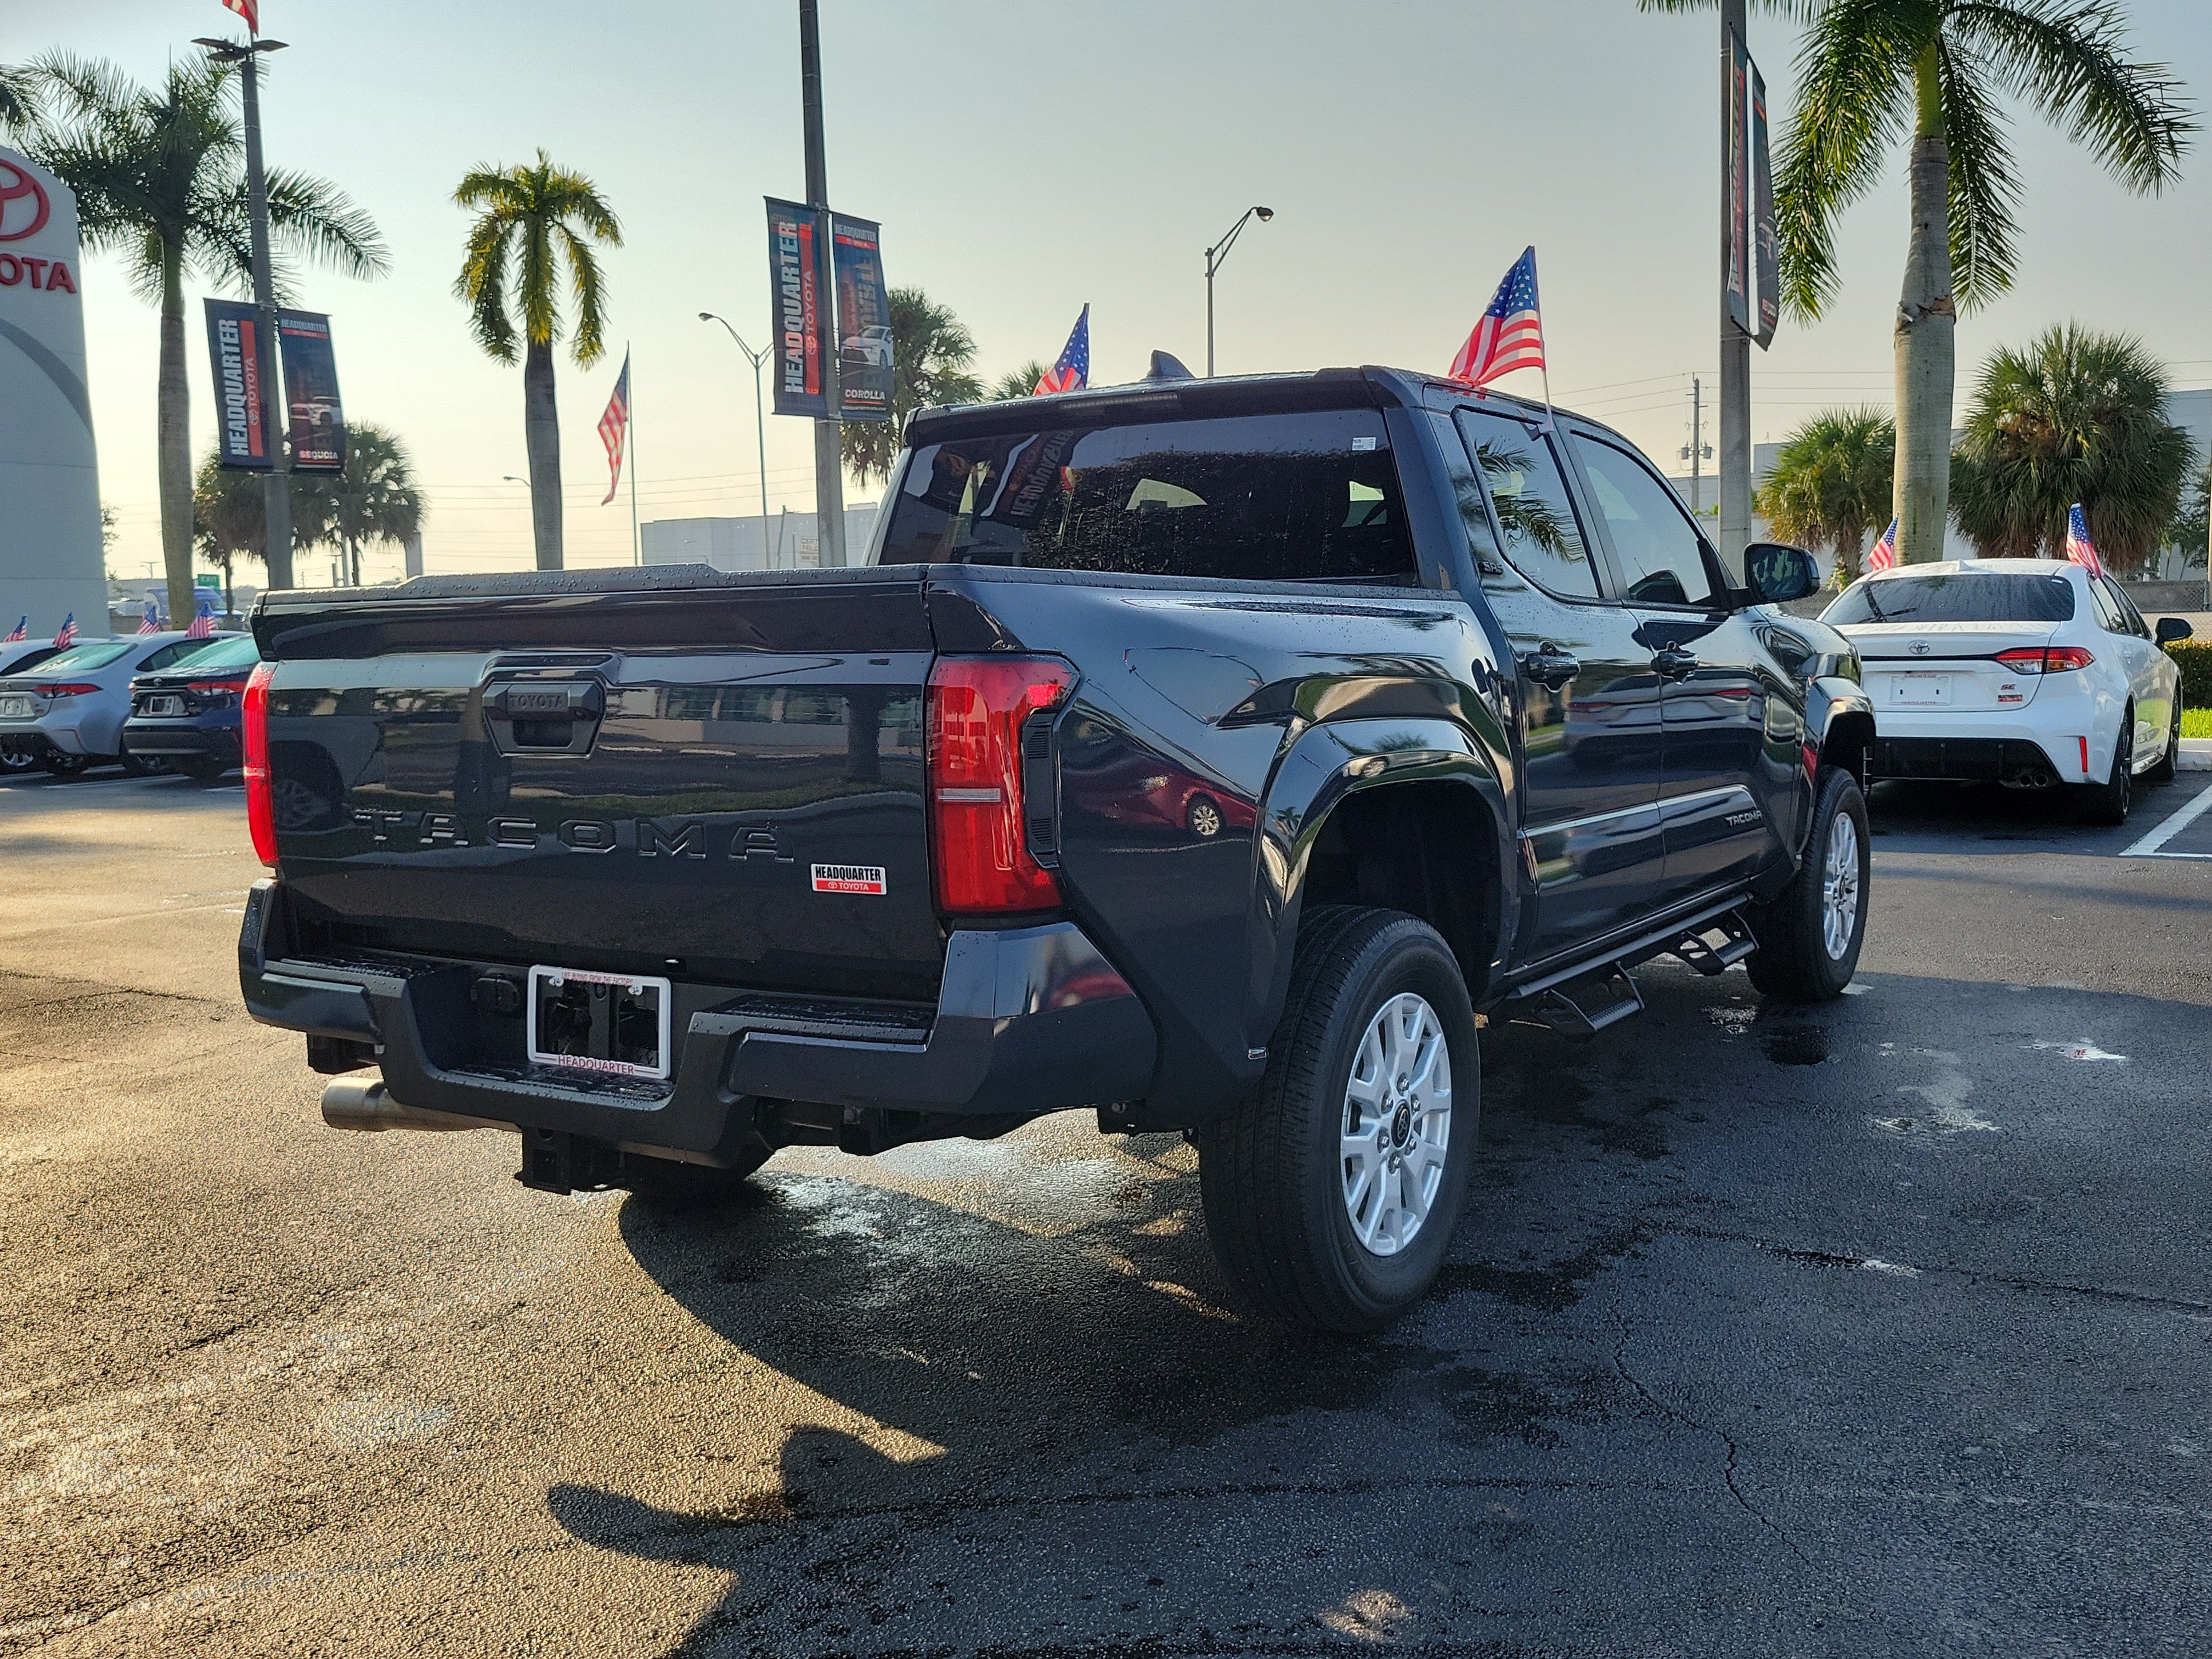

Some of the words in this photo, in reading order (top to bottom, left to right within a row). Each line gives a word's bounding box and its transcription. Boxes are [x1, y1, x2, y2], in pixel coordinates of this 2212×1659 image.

[779, 221, 804, 393] HEADQUARTER
[804, 270, 815, 333] TOYOTA
[219, 319, 249, 456] HEADQUARTER
[245, 357, 257, 407] TOYOTA
[845, 389, 885, 400] COROLLA
[299, 450, 338, 460] SEQUOIA
[510, 695, 564, 709] TOYOTA
[1725, 810, 1762, 827] TACOMA
[354, 808, 795, 862] TACOMA
[815, 866, 882, 881] HEADQUARTER
[839, 882, 869, 890] TOYOTA
[590, 974, 602, 983] FROM
[558, 1055, 635, 1074] HEADQUARTER
